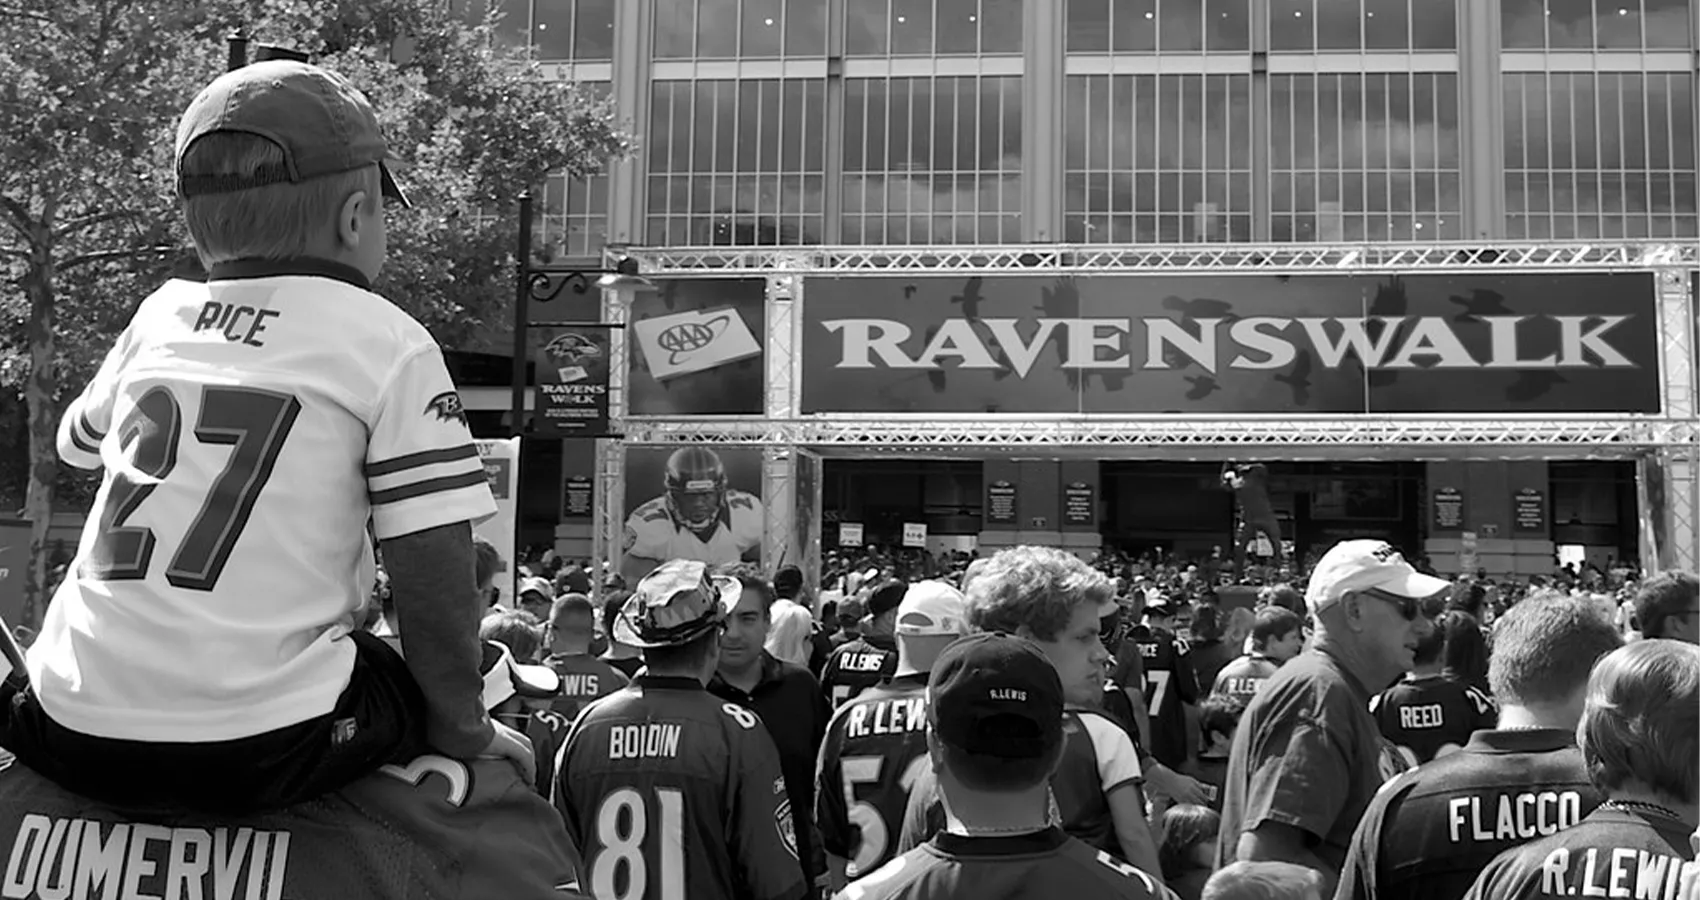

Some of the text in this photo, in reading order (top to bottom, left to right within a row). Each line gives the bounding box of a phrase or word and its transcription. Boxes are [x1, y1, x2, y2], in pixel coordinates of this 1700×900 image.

[194, 301, 280, 347] RICE
[665, 325, 709, 351] AAA
[541, 384, 606, 394] RAVENS
[77, 385, 302, 592] 27
[559, 675, 598, 696] WIS
[1142, 670, 1171, 717] 7
[1400, 704, 1443, 728] REED
[1450, 791, 1581, 842] FLACCO
[591, 787, 684, 900] 81
